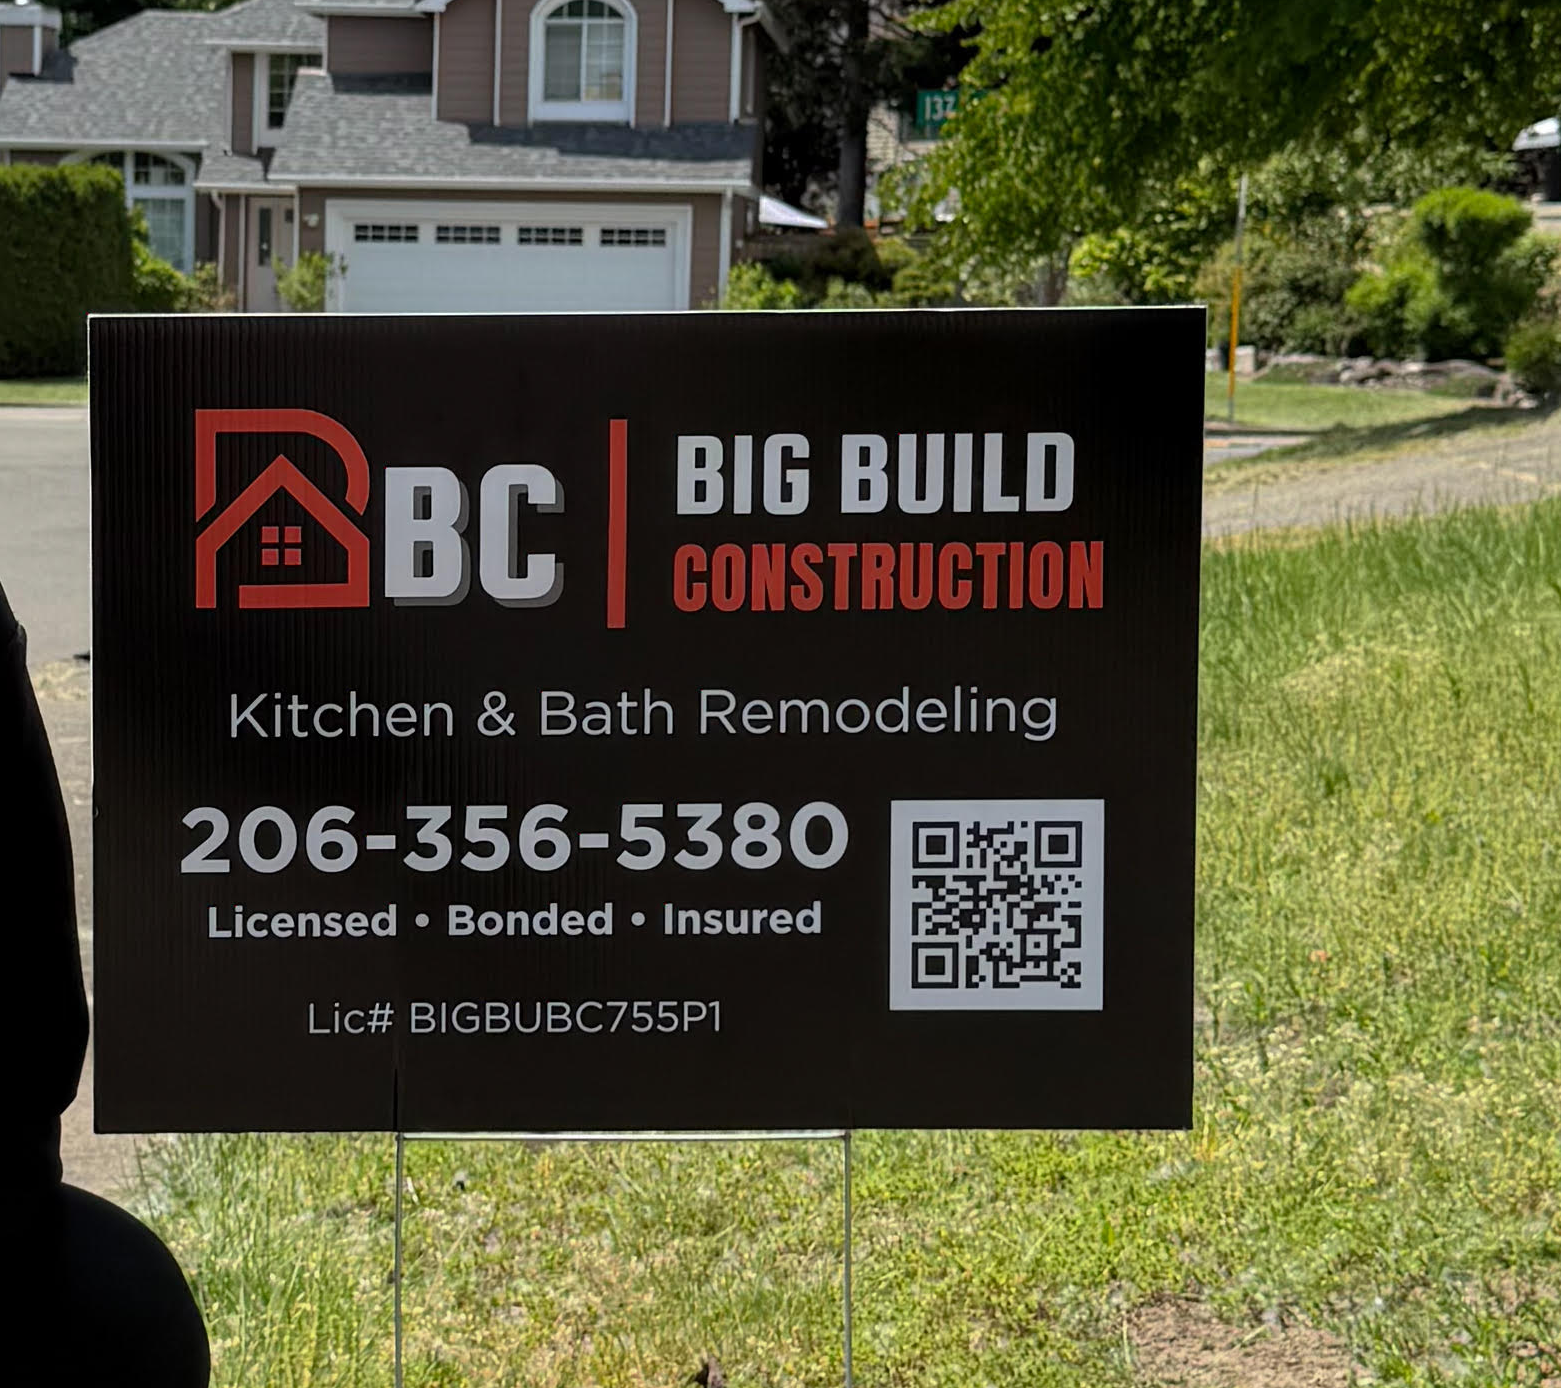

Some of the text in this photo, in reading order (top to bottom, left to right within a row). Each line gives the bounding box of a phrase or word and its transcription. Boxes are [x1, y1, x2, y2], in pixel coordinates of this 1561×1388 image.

[676, 432, 1075, 515] BIG BUILD
[673, 540, 1105, 611] CONSTRUCTION
[229, 685, 1058, 741] Kitchen & Bath Remodeling
[180, 801, 849, 873] 206-356-5380
[208, 900, 822, 938] Licensed Bonded Insured
[308, 1000, 721, 1034] Lic# BIGBUBC755P1
